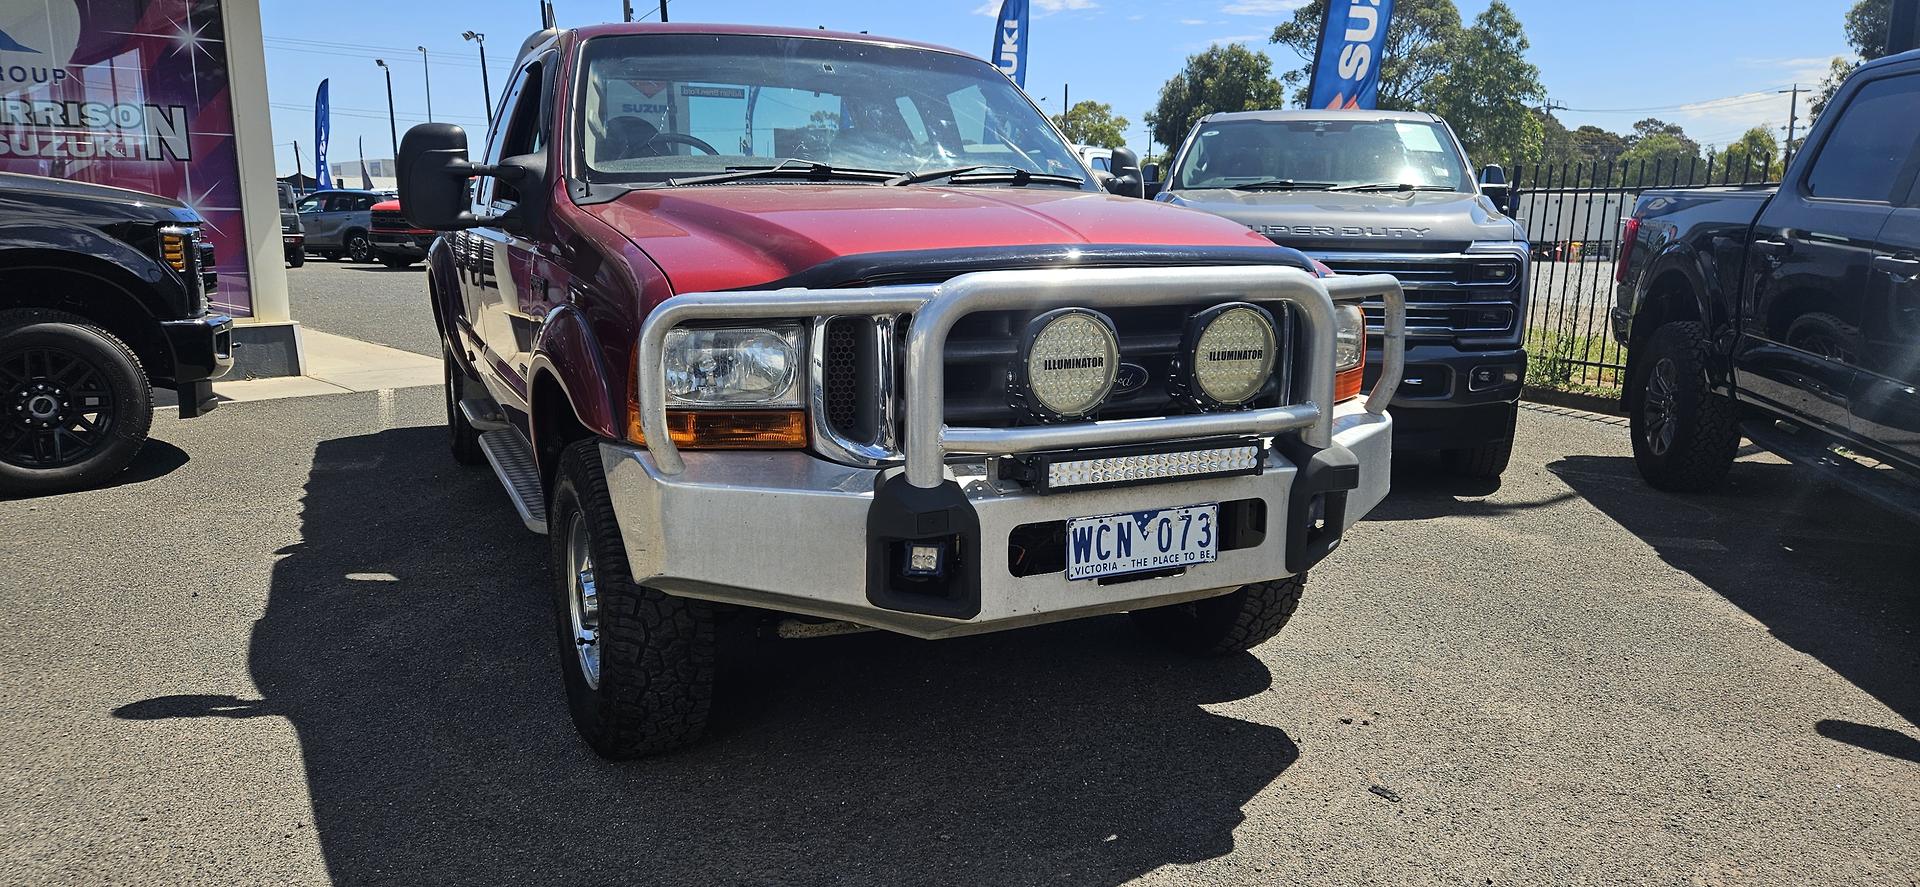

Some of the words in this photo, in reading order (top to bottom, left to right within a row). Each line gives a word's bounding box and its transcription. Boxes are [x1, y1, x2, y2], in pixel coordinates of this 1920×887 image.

[1339, 0, 1380, 81] SU
[1246, 224, 1335, 238] UPER
[1340, 226, 1431, 239] DUTY
[1044, 356, 1104, 371] ILLUMINATOR
[1209, 349, 1263, 362] ILLUMINATOR
[1072, 521, 1132, 564] WCN
[1157, 512, 1212, 552] 073
[1075, 563, 1118, 576] VICTORIA
[1132, 558, 1148, 568] THE
[1153, 554, 1179, 566] PLACE
[1184, 551, 1195, 561] TO
